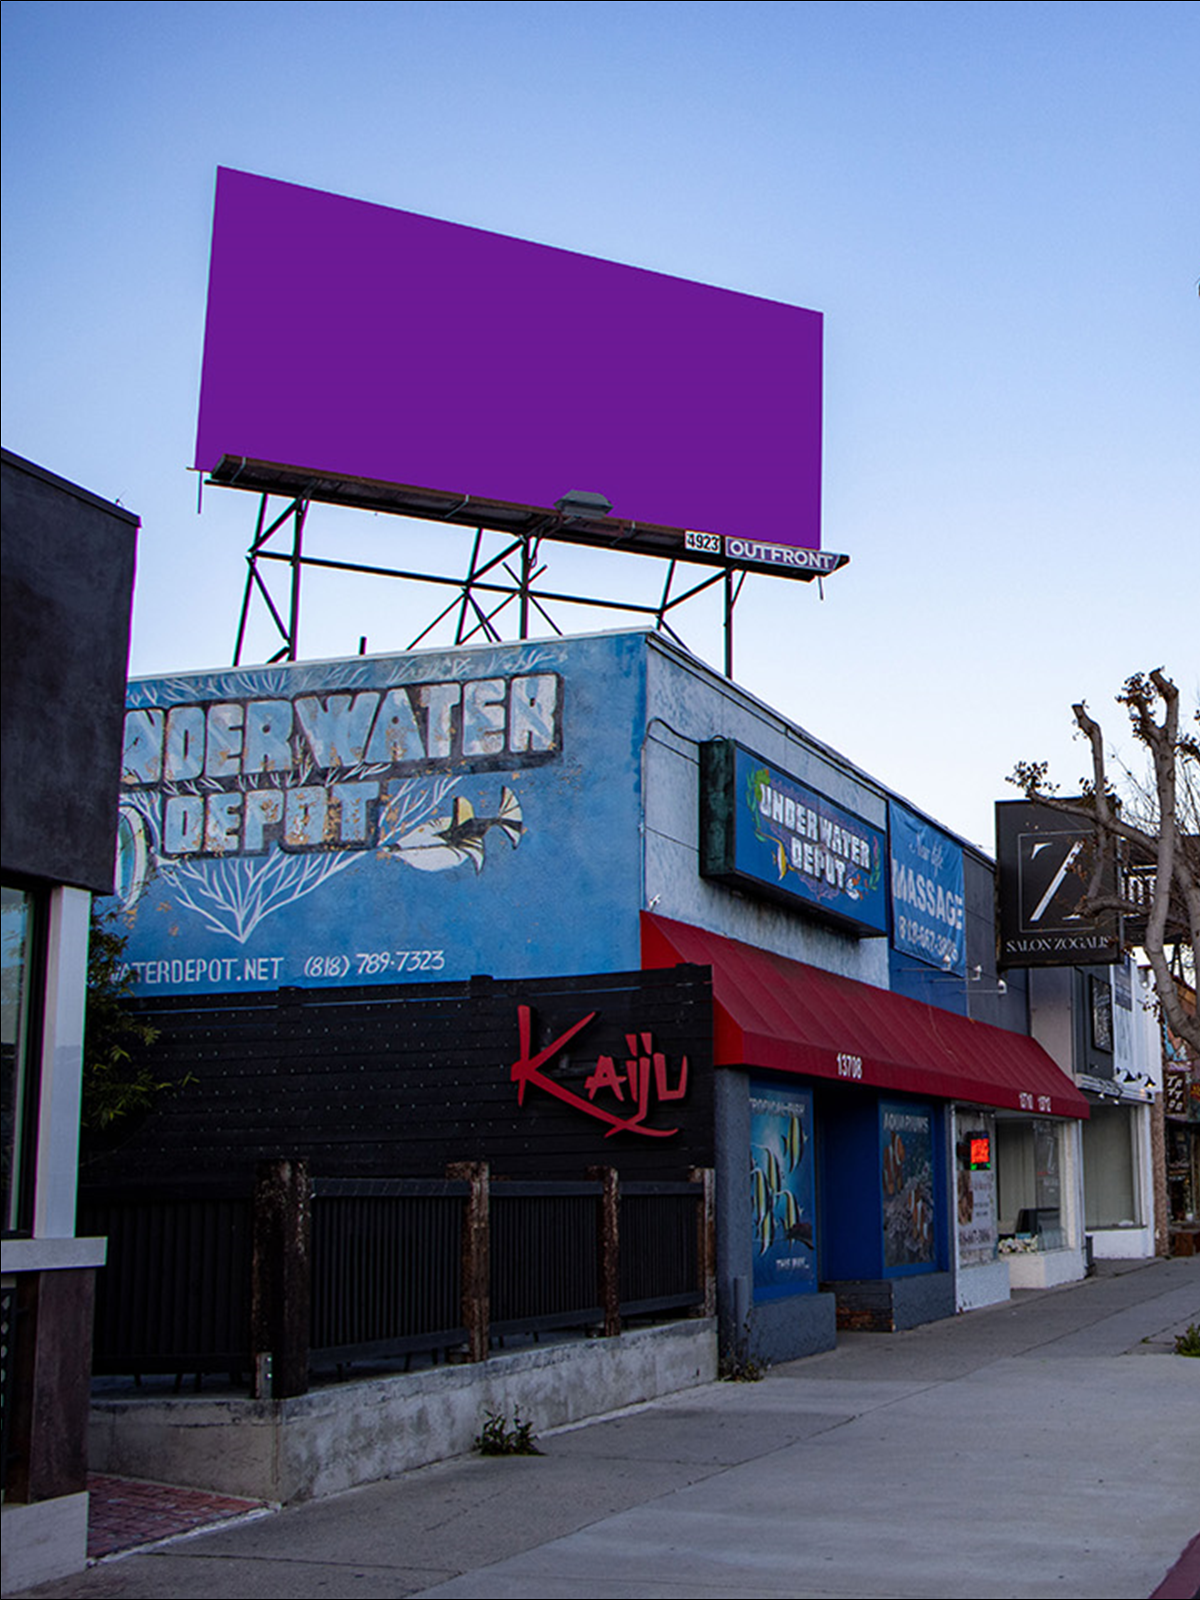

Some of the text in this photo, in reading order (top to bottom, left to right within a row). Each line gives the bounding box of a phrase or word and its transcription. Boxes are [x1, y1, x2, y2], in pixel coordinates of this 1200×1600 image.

[686, 532, 720, 551] 4923
[730, 541, 833, 569] OUTFRONT
[163, 781, 381, 854] DEPOT
[760, 783, 870, 869] UNDERWATER
[791, 837, 846, 891] DEPOT
[892, 858, 963, 930] MASSAGE
[1006, 938, 1052, 953] SALON
[304, 955, 350, 978] (818)
[836, 1052, 863, 1079] 13708
